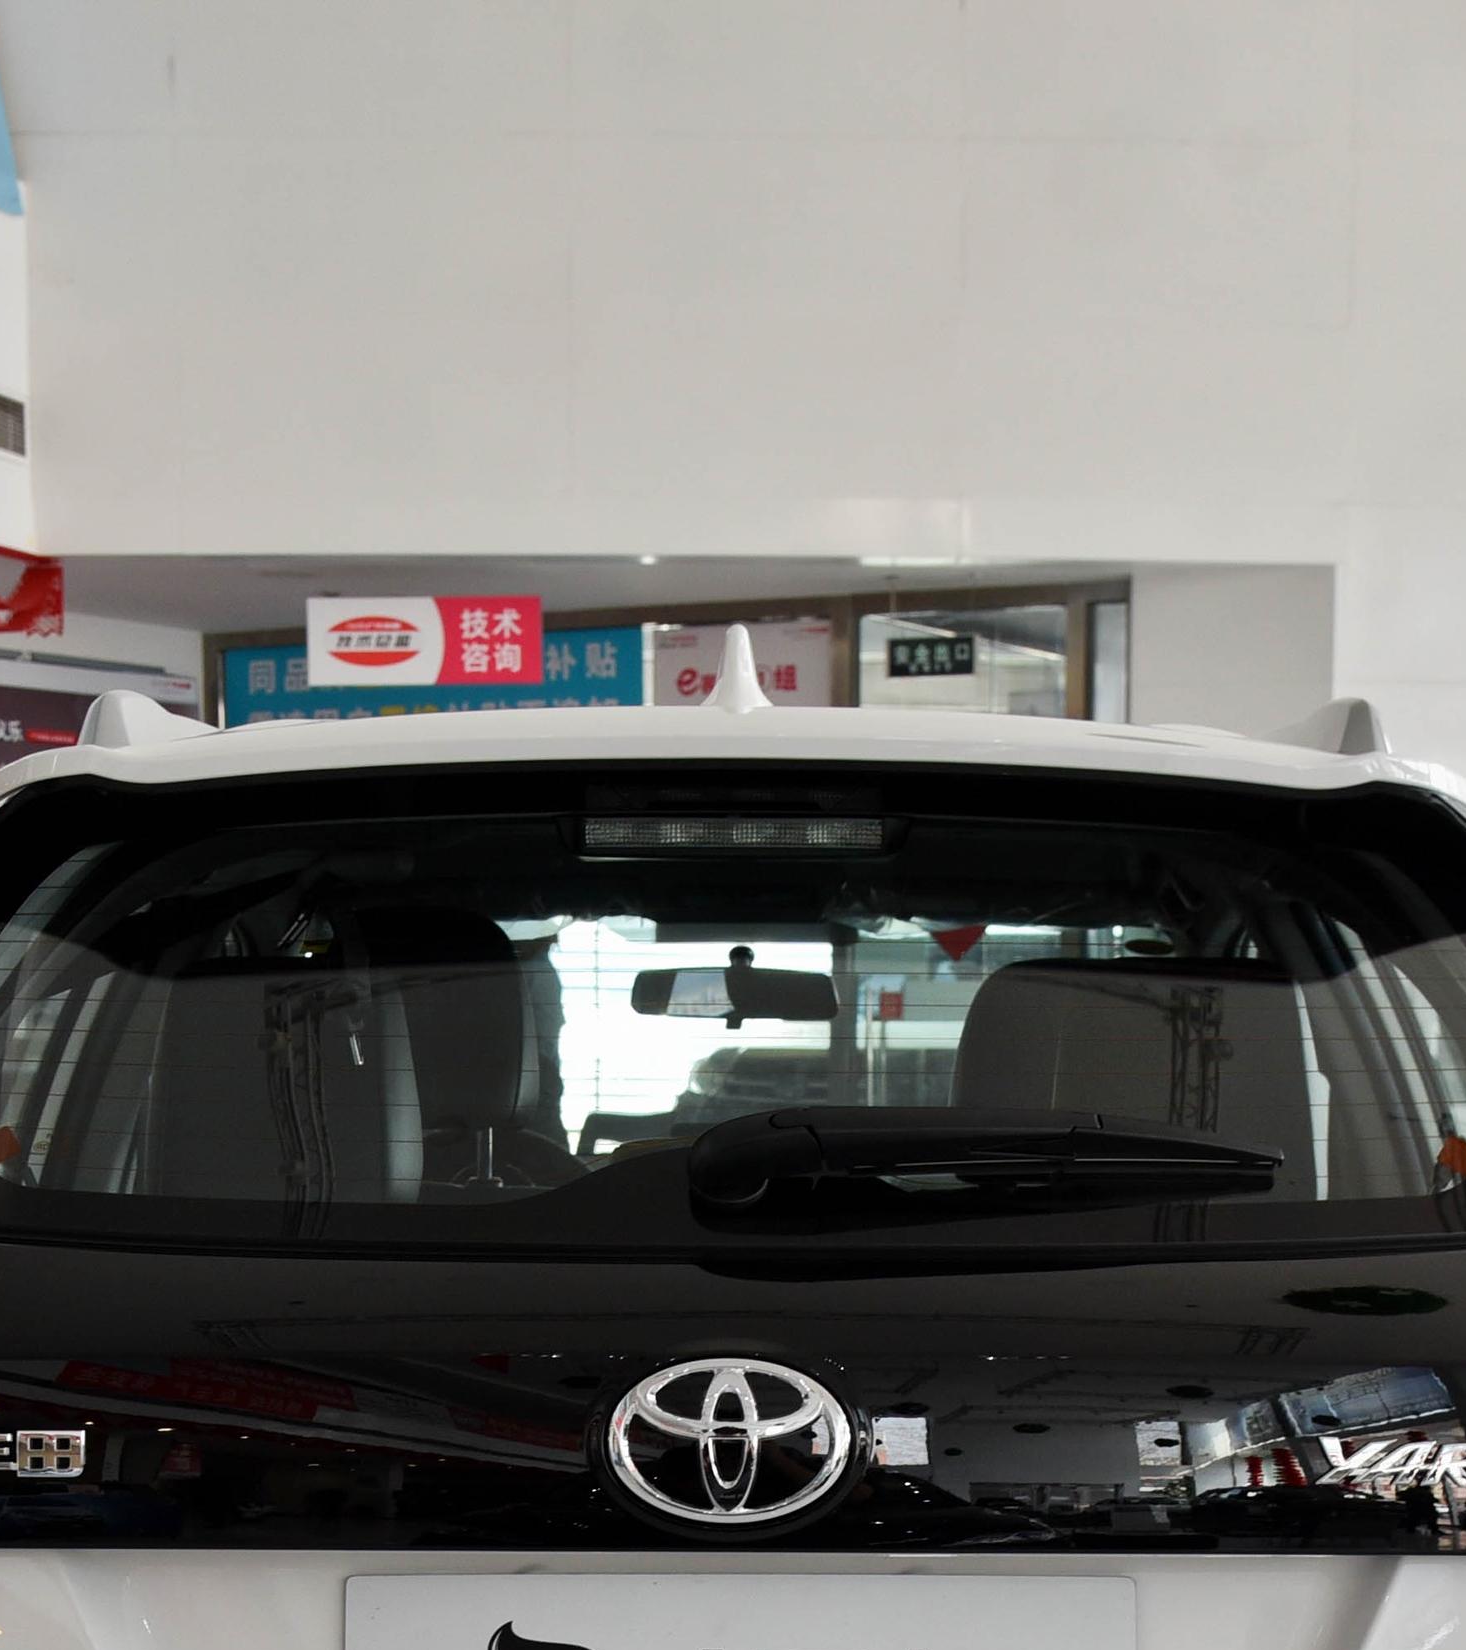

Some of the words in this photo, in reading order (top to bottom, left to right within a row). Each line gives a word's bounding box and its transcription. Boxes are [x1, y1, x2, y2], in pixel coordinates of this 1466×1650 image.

[460, 608, 522, 640] 技术
[461, 643, 522, 674] 咨询
[546, 641, 616, 681] 补贴
